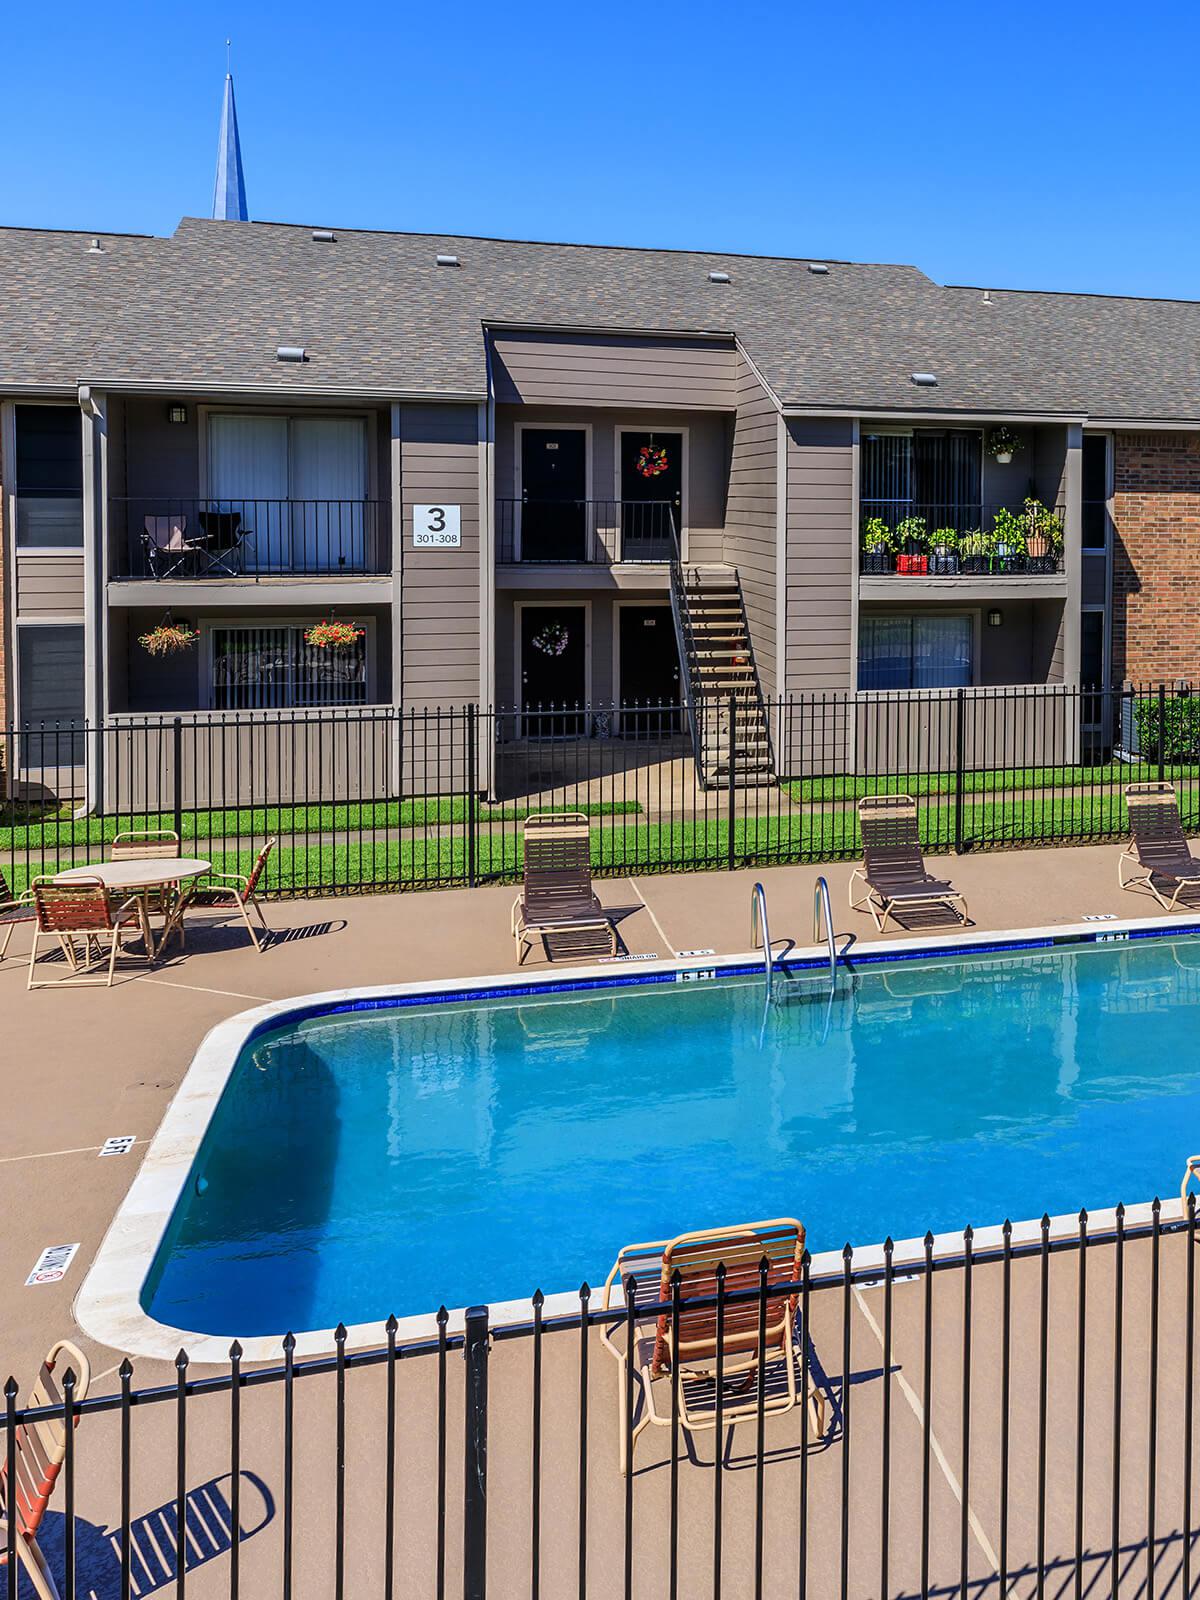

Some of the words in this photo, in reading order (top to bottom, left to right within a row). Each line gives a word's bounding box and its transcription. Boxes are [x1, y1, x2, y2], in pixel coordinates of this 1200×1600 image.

[428, 507, 446, 532] 3
[416, 534, 458, 544] 301-308
[697, 970, 714, 979] FT
